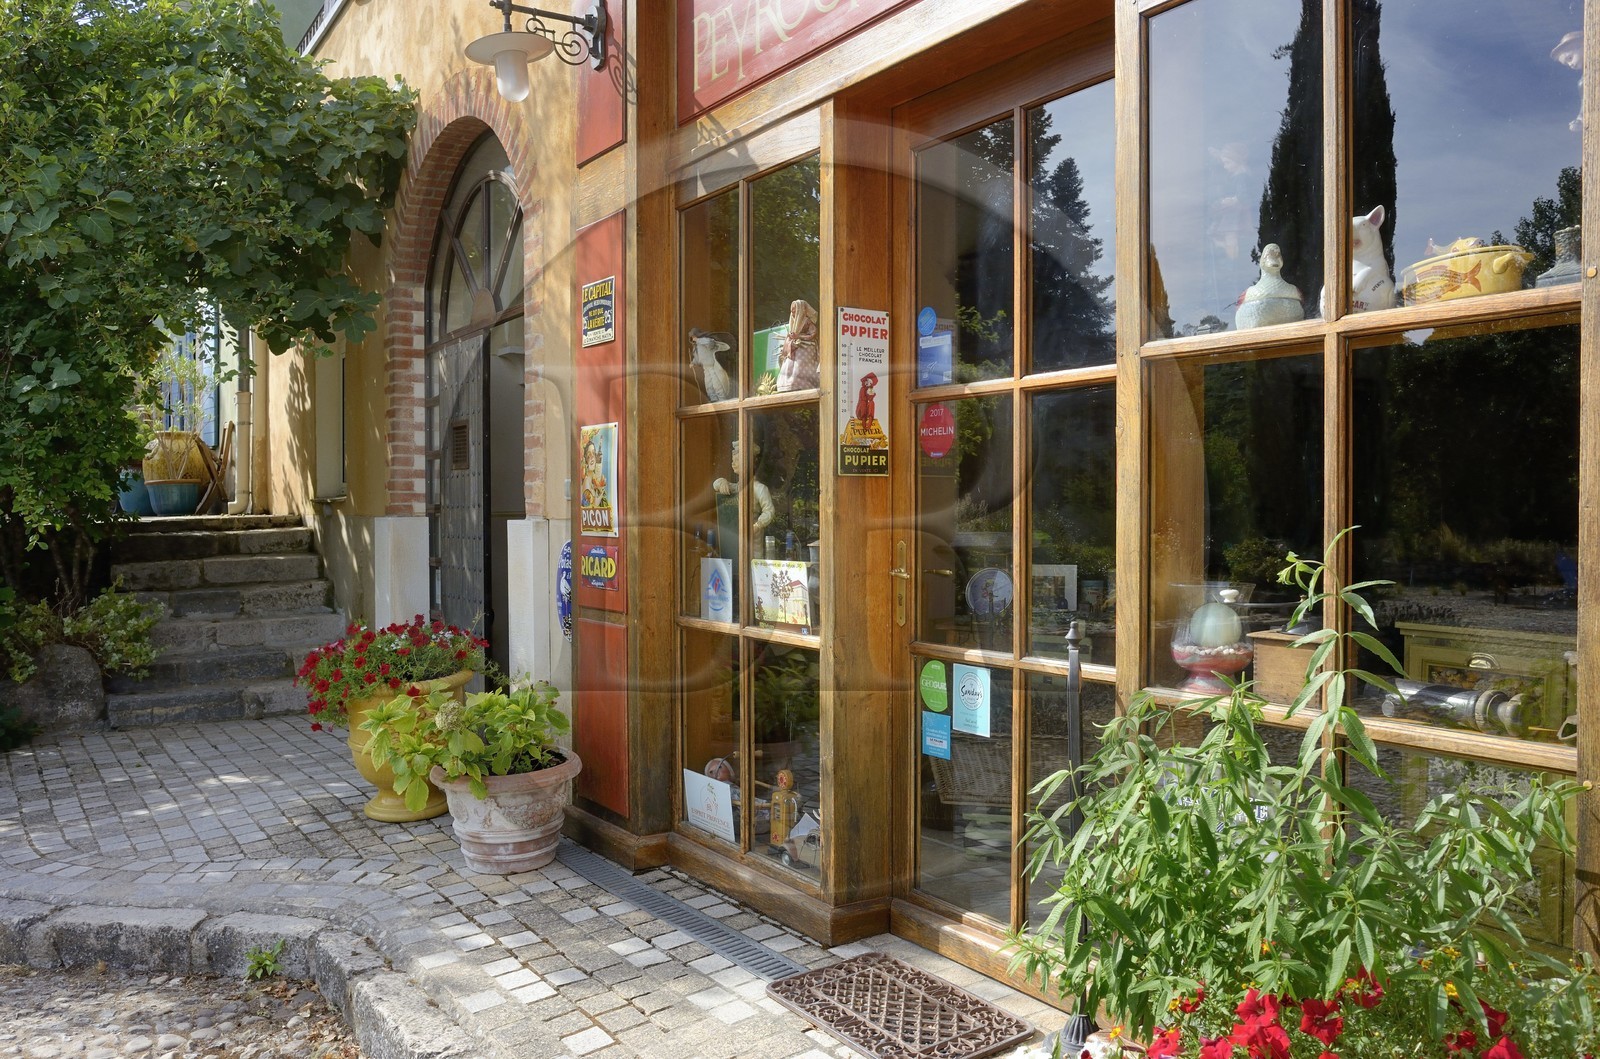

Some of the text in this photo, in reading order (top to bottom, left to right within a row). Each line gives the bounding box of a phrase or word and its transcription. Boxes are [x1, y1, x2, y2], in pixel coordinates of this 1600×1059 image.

[582, 281, 612, 303] LE CAPITAL
[842, 312, 887, 325] CHOCOLAT
[841, 324, 889, 340] PUPIER
[863, 346, 885, 354] MEILLEUR
[929, 408, 945, 417] 2017
[920, 426, 954, 436] MICHELIN
[843, 446, 870, 454] CHOCOLAT
[845, 454, 887, 466] PUPIER
[582, 509, 609, 527] PICON
[581, 555, 616, 579] RICARD
